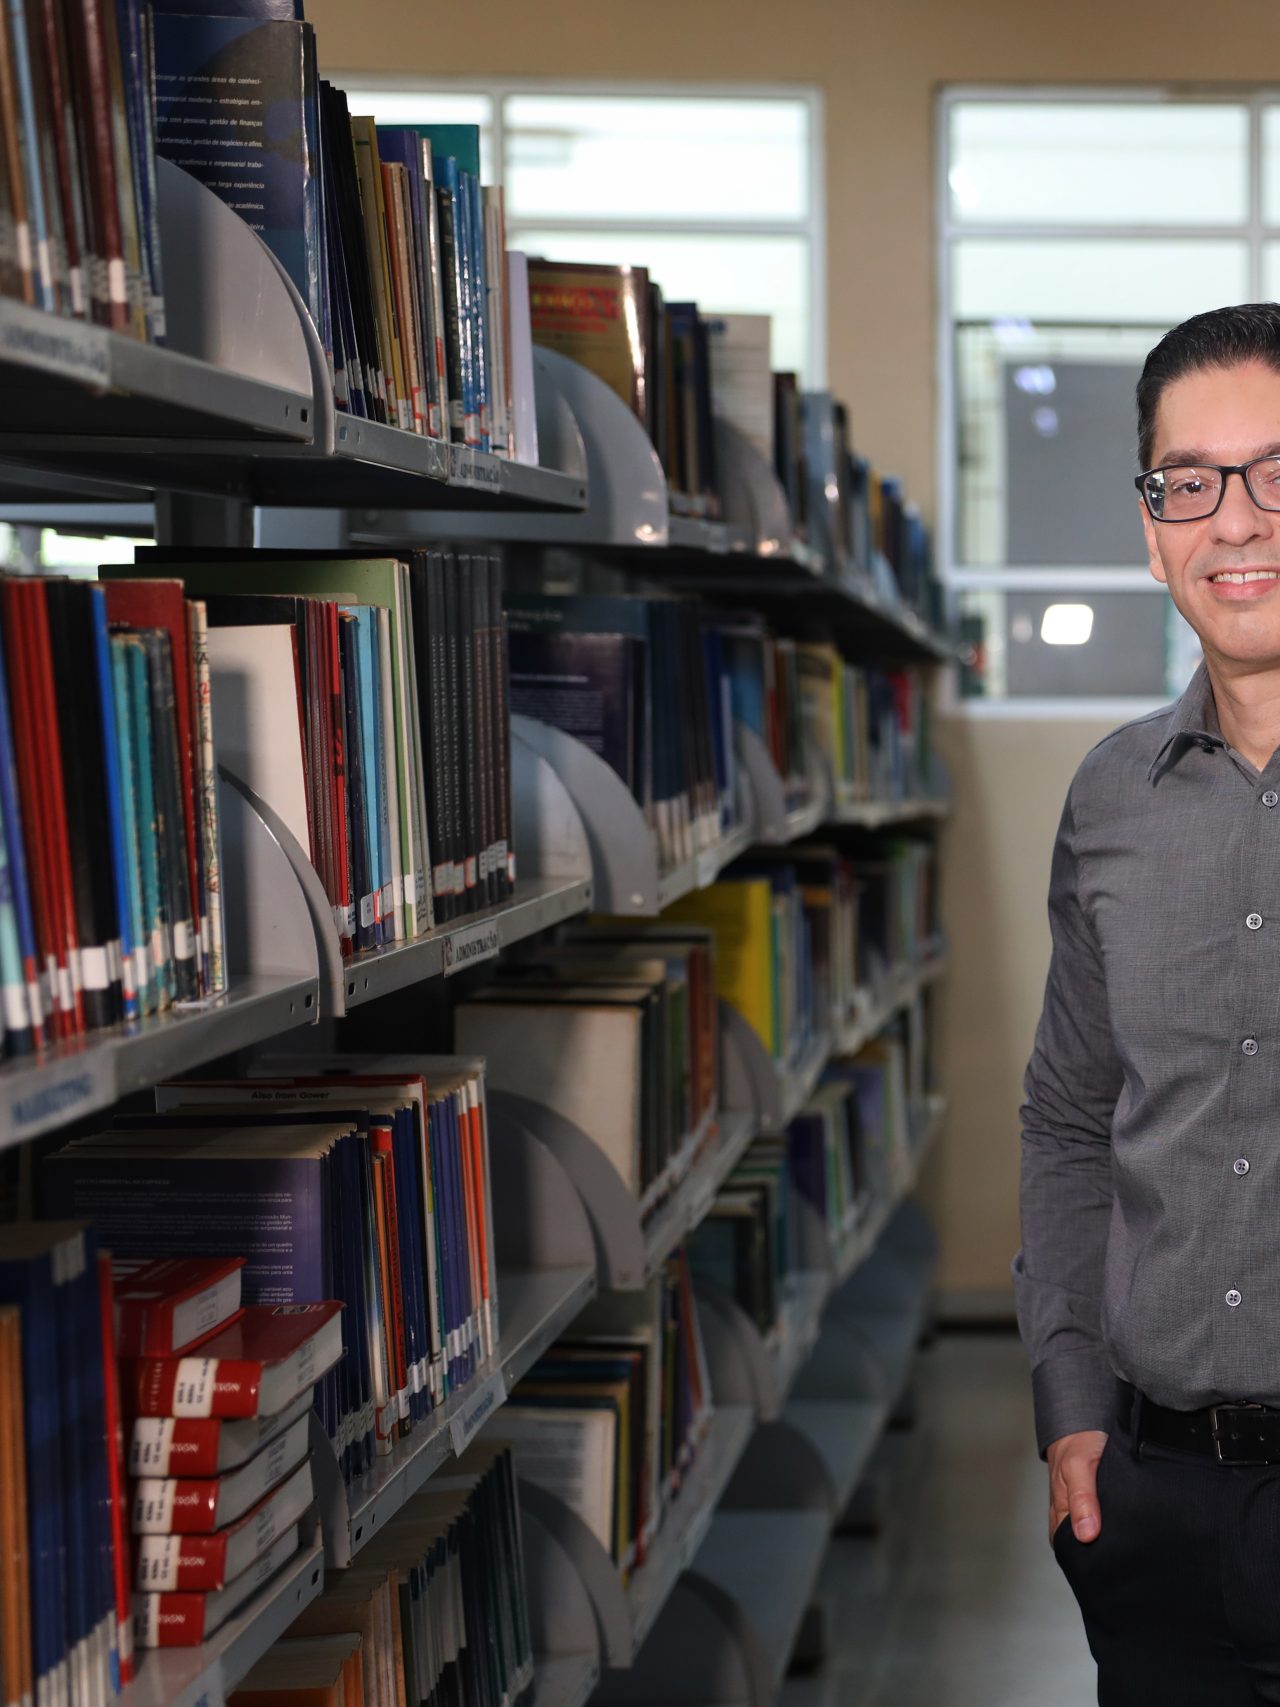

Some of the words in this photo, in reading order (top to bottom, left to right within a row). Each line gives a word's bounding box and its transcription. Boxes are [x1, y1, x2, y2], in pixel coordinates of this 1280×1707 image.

[251, 1091, 272, 1100] Also
[275, 1091, 297, 1100] from
[300, 1091, 330, 1100] Gower
